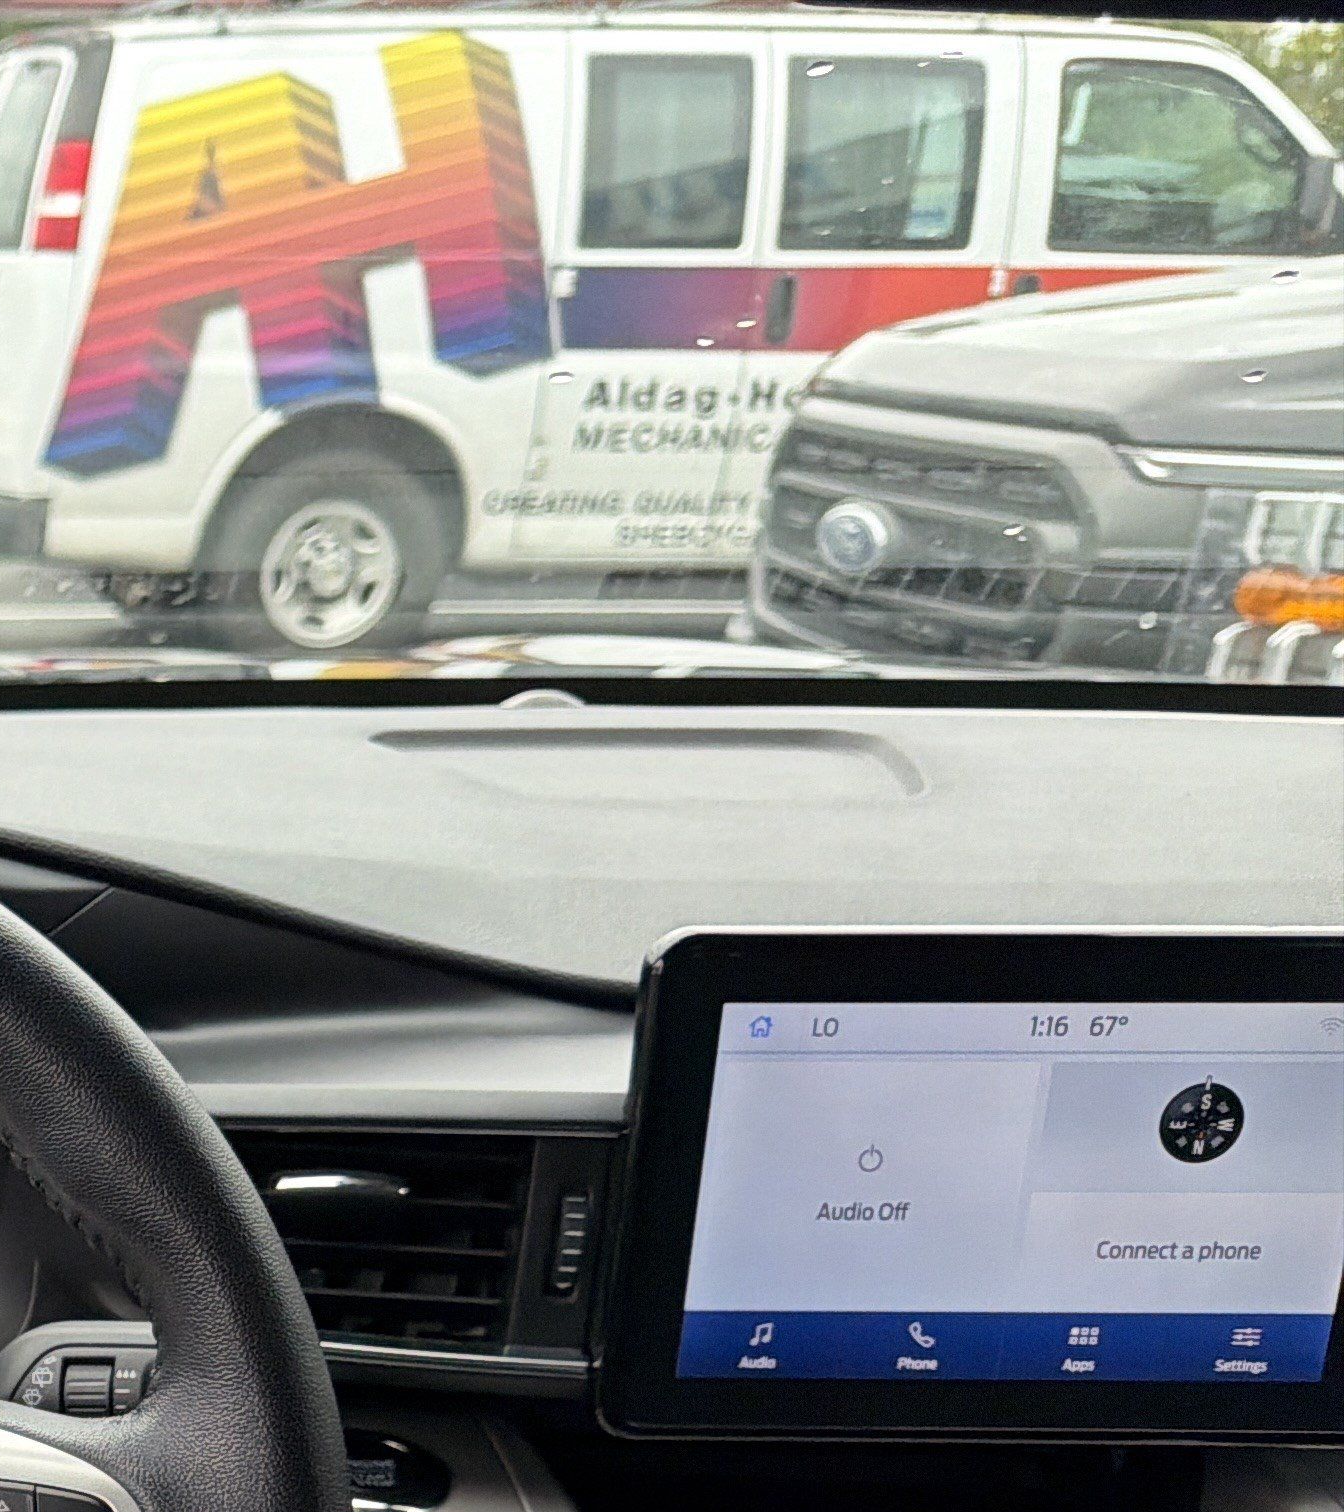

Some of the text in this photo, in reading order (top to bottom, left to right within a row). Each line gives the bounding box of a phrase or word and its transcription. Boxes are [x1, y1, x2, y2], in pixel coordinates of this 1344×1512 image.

[811, 1016, 840, 1038] LO
[1030, 1015, 1129, 1038] 1:16 67°
[1200, 1093, 1212, 1110] S
[1192, 1139, 1205, 1155] N
[815, 1202, 911, 1221] Audio Off
[1096, 1240, 1262, 1263] Connect a phone
[738, 1356, 777, 1370] Audio
[896, 1357, 938, 1371] Phone
[1061, 1358, 1095, 1374] Apps
[1212, 1358, 1269, 1375] Settings
